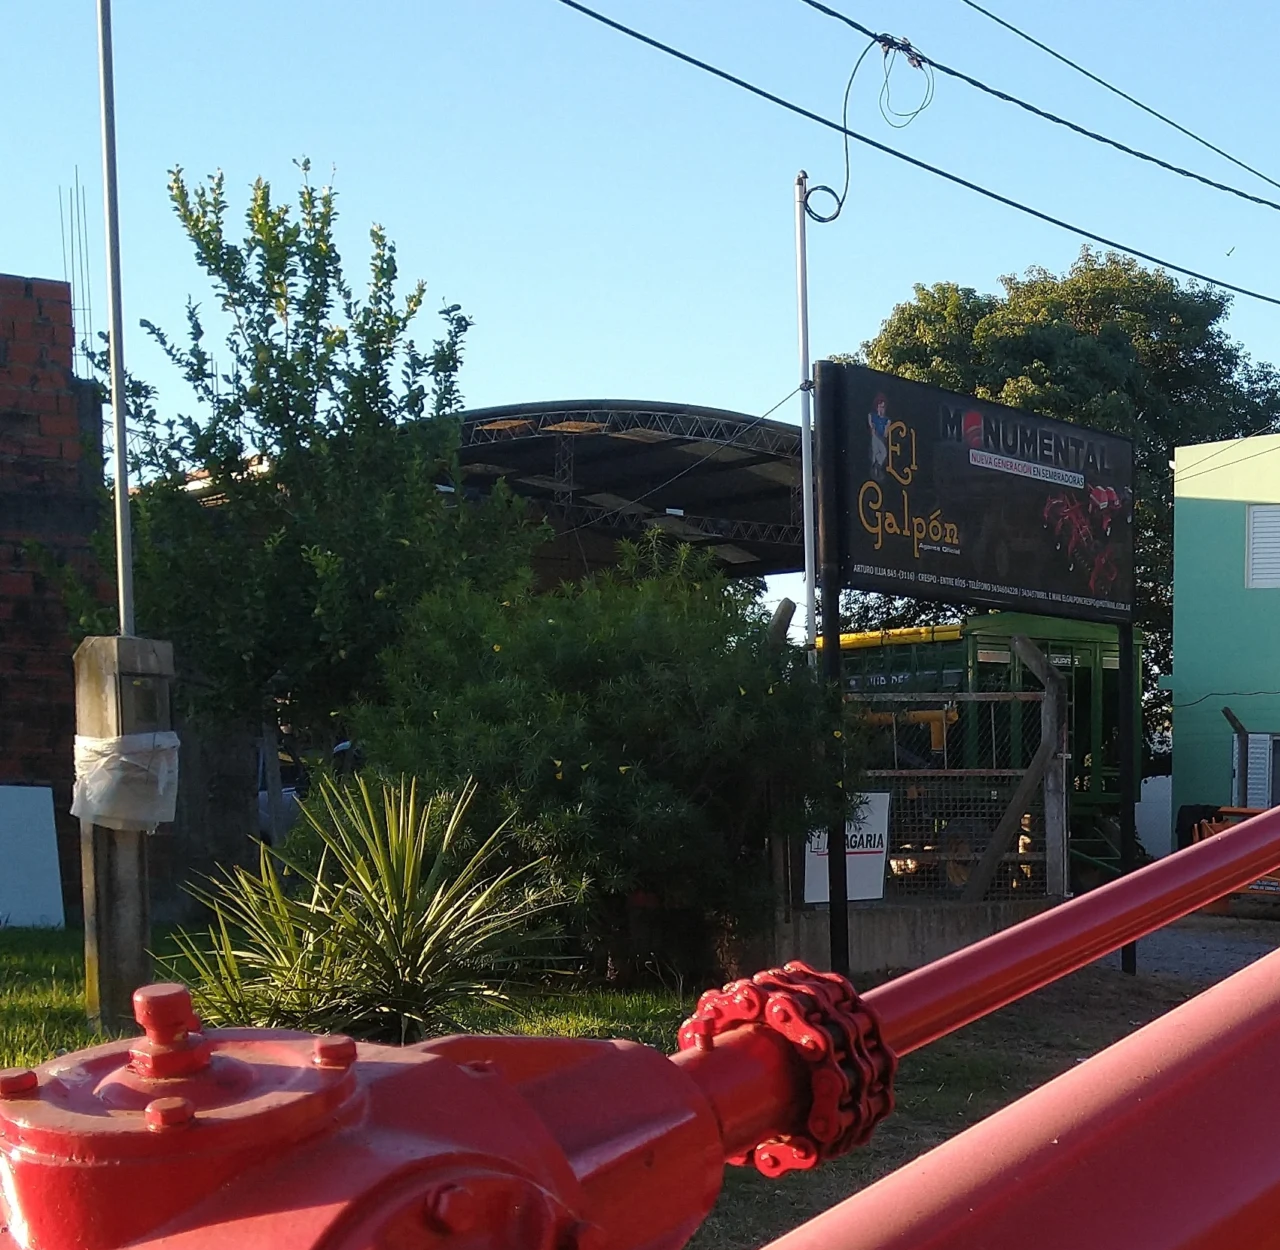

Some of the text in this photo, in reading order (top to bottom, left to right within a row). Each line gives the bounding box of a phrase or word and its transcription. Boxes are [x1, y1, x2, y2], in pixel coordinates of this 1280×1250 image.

[886, 420, 918, 486] El
[940, 404, 1112, 475] MONUMENTAL
[971, 452, 1084, 487] NUEVA GENERACIÓN EN SEMBRADORAS
[858, 480, 960, 558] Galpón
[853, 564, 874, 575] ARTURO
